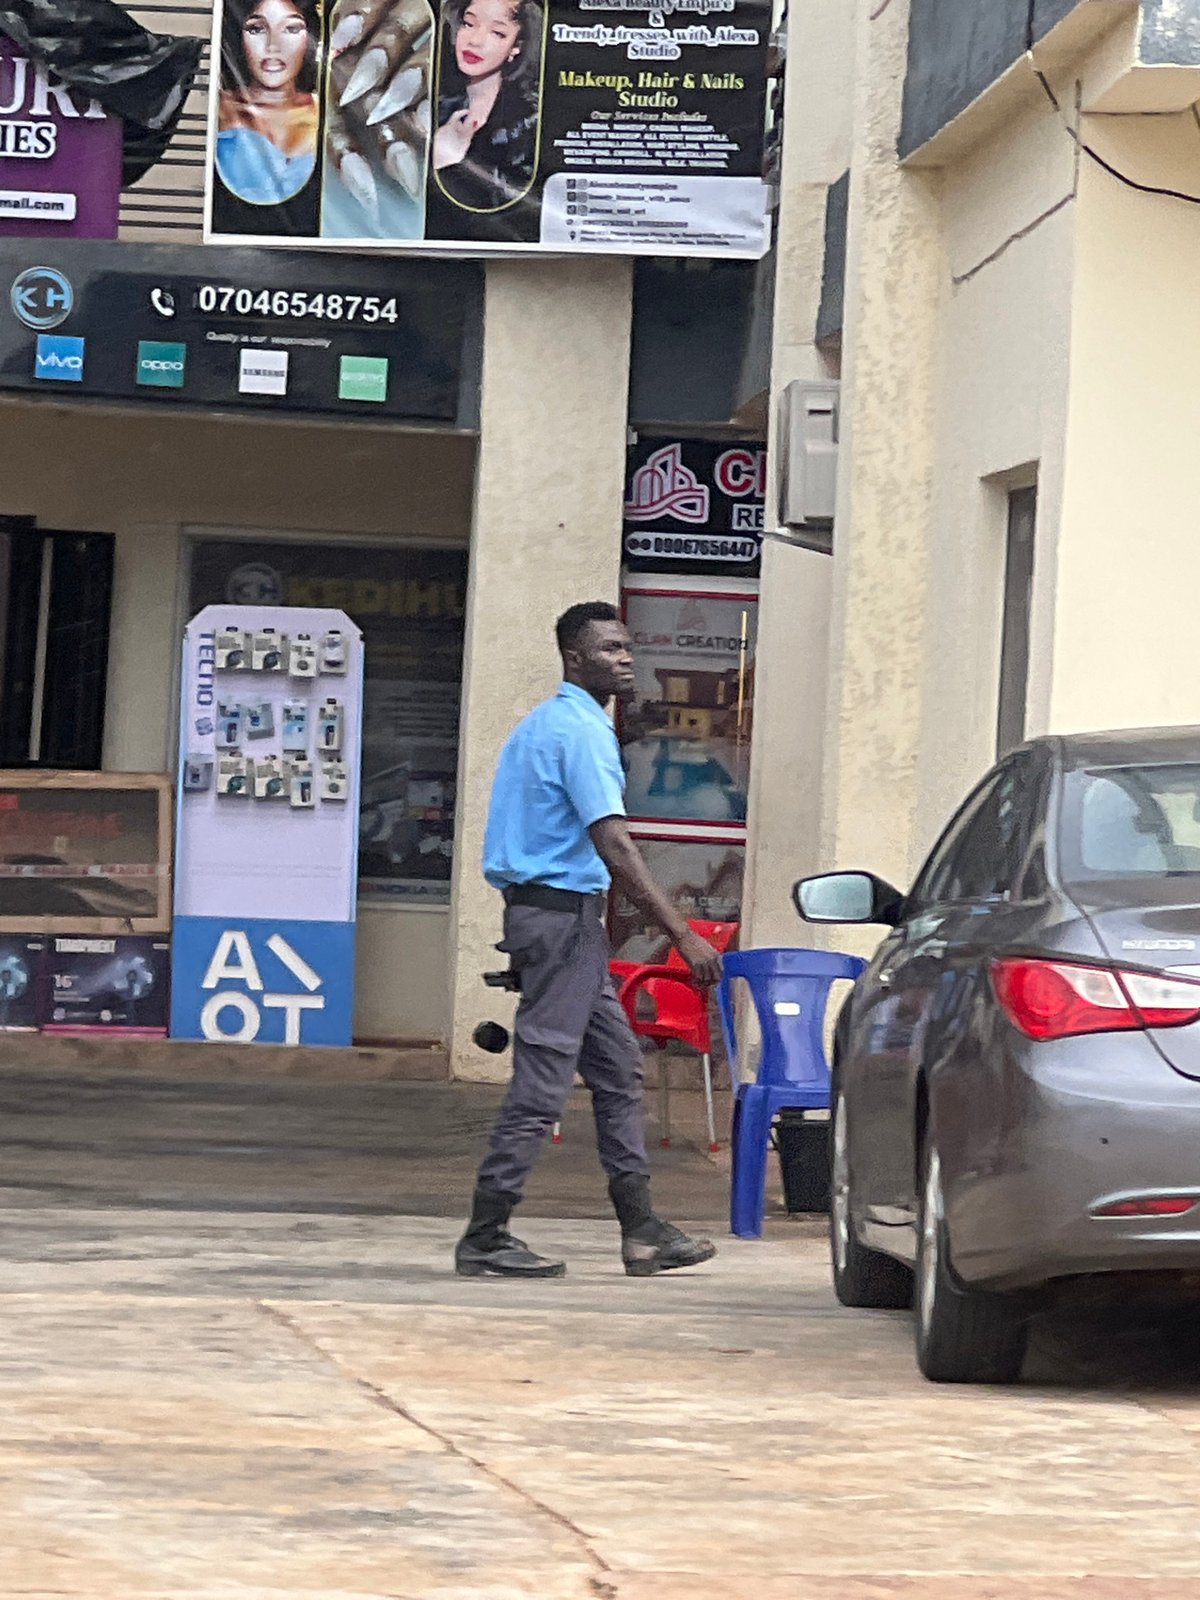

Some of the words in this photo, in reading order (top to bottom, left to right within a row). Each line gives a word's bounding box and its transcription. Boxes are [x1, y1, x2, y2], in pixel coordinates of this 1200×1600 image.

[624, 0, 674, 13] Beauty
[678, 0, 732, 14] Empire
[651, 12, 662, 24] &
[629, 44, 680, 57] Studio
[0, 56, 107, 118] UR
[559, 70, 633, 91] Makeup,
[637, 72, 680, 89] Hair
[682, 73, 695, 89] &
[700, 73, 745, 90] Nails
[617, 91, 679, 108] Studio
[199, 285, 398, 323] 07046548754
[38, 353, 82, 368] vivo
[141, 358, 184, 373] oppo
[196, 632, 216, 706] TECNO
